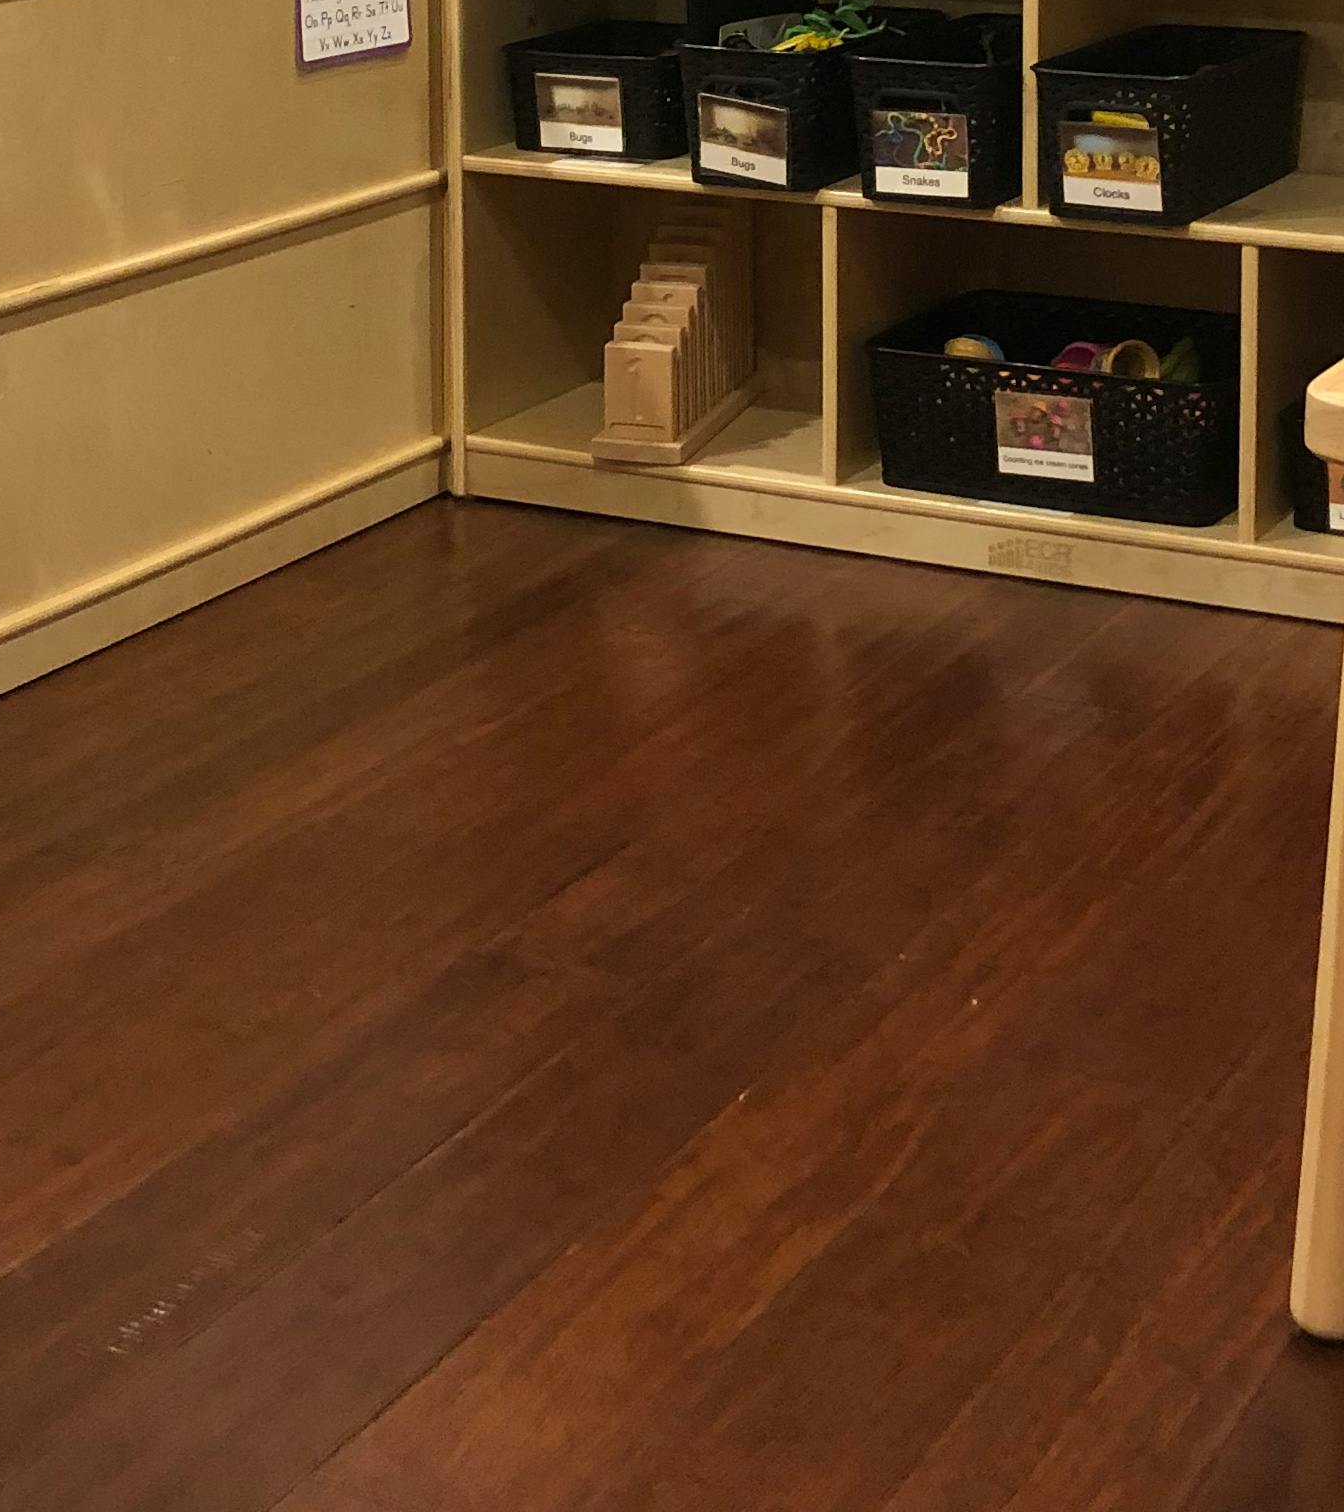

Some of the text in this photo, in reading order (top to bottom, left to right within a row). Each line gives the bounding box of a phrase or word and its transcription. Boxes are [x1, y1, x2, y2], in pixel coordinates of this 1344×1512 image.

[305, 15, 318, 28] Oo
[321, 12, 332, 30] Pp
[336, 9, 350, 26] Qq
[366, 4, 375, 17] Ss
[392, 0, 403, 12] Uu
[320, 39, 329, 51] Vv
[367, 30, 377, 46] Yy
[381, 26, 391, 40] Zz
[569, 131, 593, 146] Bugs
[731, 156, 756, 172] Bugs
[902, 173, 941, 188] Snakes
[1093, 186, 1131, 201] Clocks
